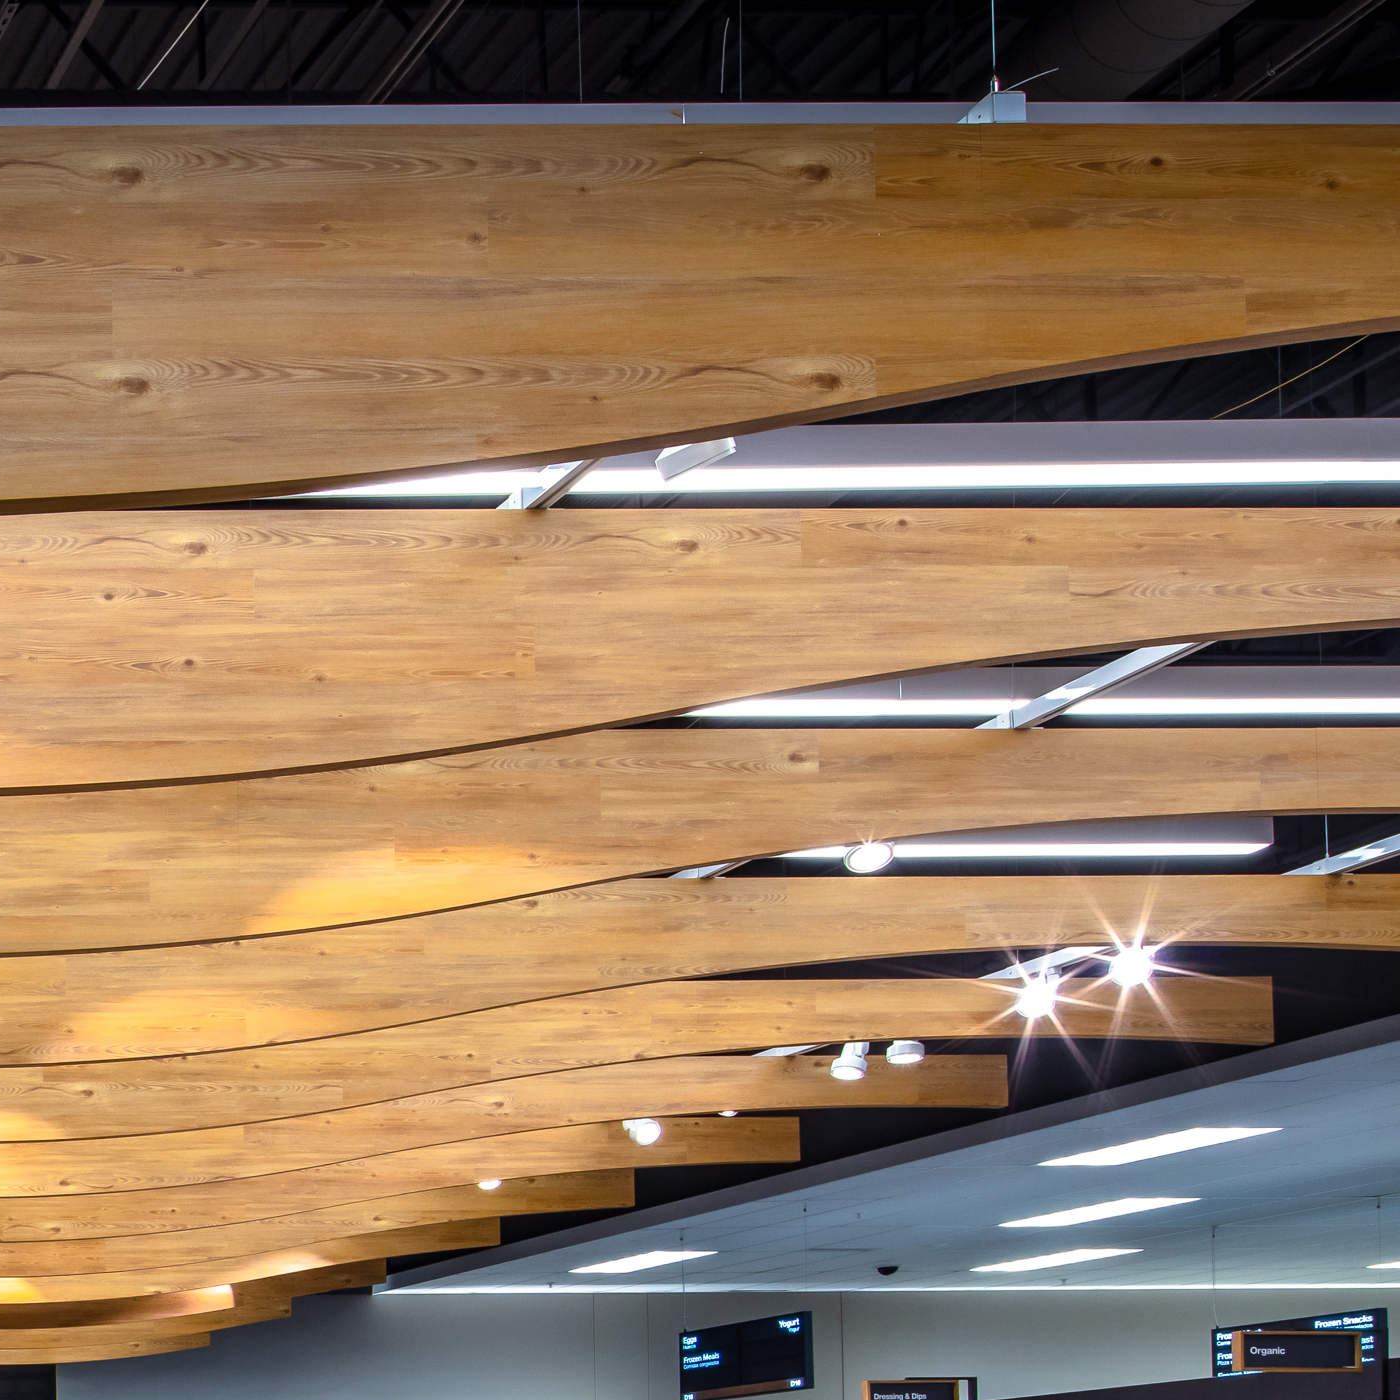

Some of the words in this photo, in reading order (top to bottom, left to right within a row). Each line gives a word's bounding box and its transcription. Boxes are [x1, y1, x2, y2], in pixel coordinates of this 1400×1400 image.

[779, 1318, 800, 1328] Yogurt
[1315, 1319, 1342, 1329] Frozen
[1343, 1314, 1374, 1326] Snacks
[1250, 1346, 1286, 1356] Organic
[684, 1356, 702, 1364] Frozen
[703, 1352, 720, 1361] Meals
[904, 1392, 910, 1400] &
[911, 1392, 927, 1400] Dips
